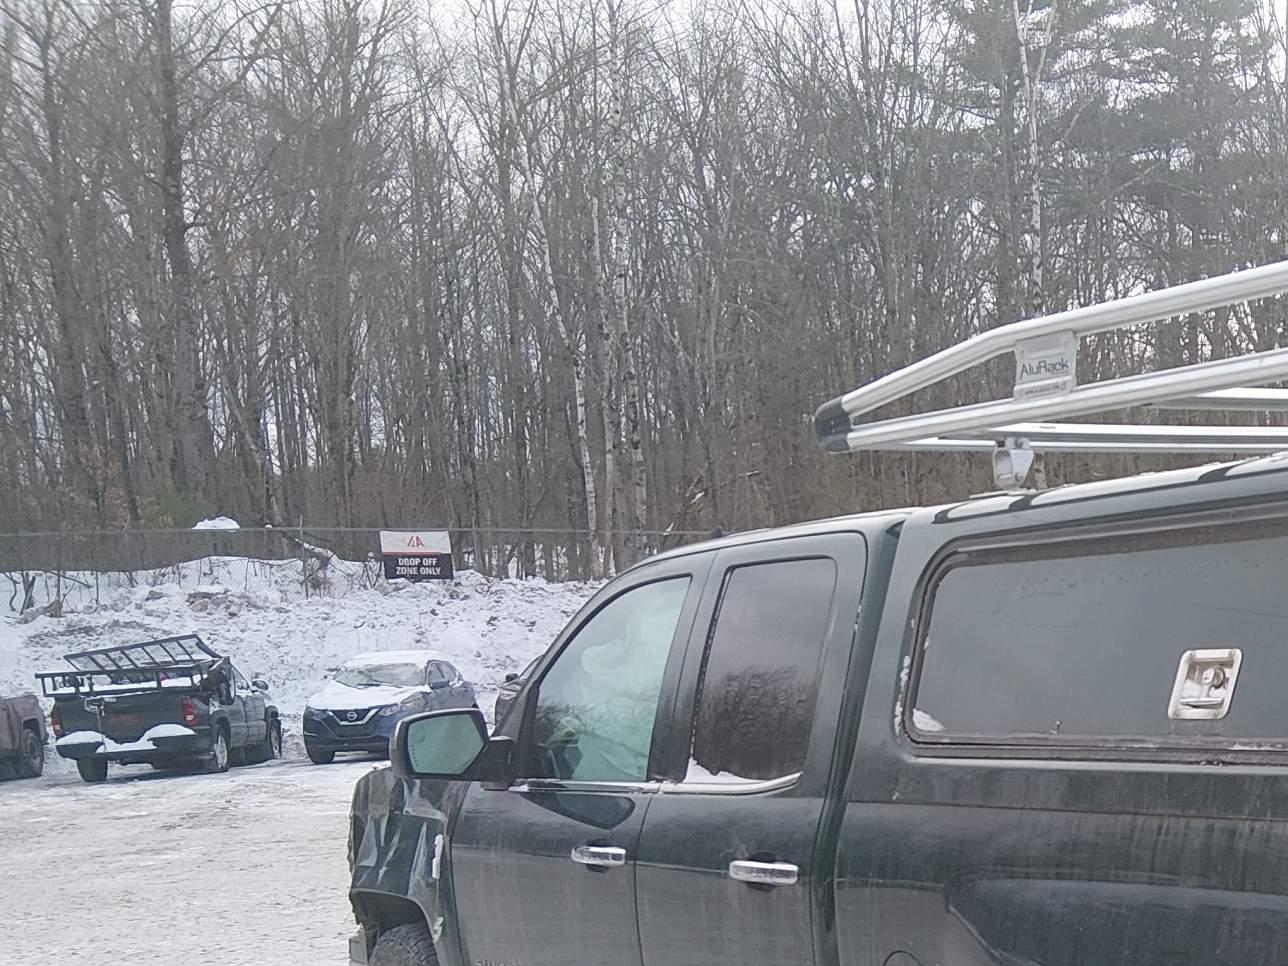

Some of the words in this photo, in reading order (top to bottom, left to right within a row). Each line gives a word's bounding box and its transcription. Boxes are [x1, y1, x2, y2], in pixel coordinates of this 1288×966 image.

[1020, 357, 1069, 380] AluRack
[422, 557, 438, 566] OFF
[395, 566, 419, 575] ZONE
[419, 566, 441, 575] ONLY
